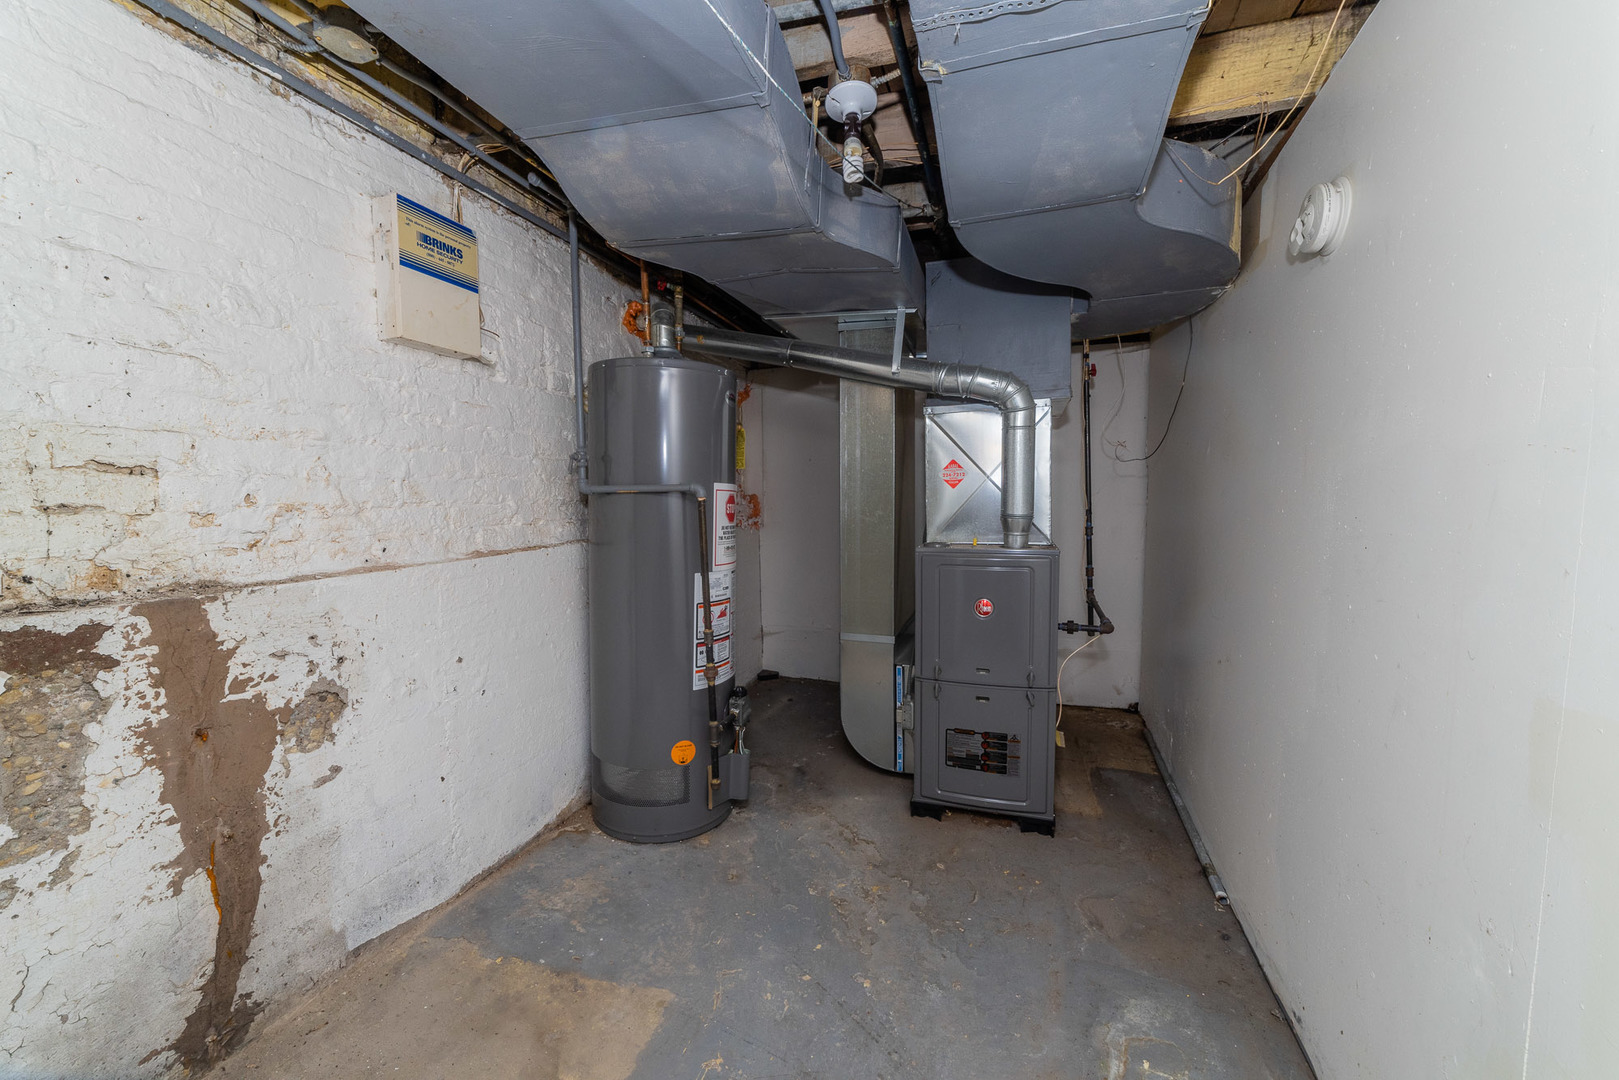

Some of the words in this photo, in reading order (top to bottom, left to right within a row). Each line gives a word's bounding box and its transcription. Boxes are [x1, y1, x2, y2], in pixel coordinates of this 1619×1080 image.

[416, 242, 435, 253] HOME
[436, 250, 463, 264] SECURITY
[425, 235, 463, 259] BRINKS
